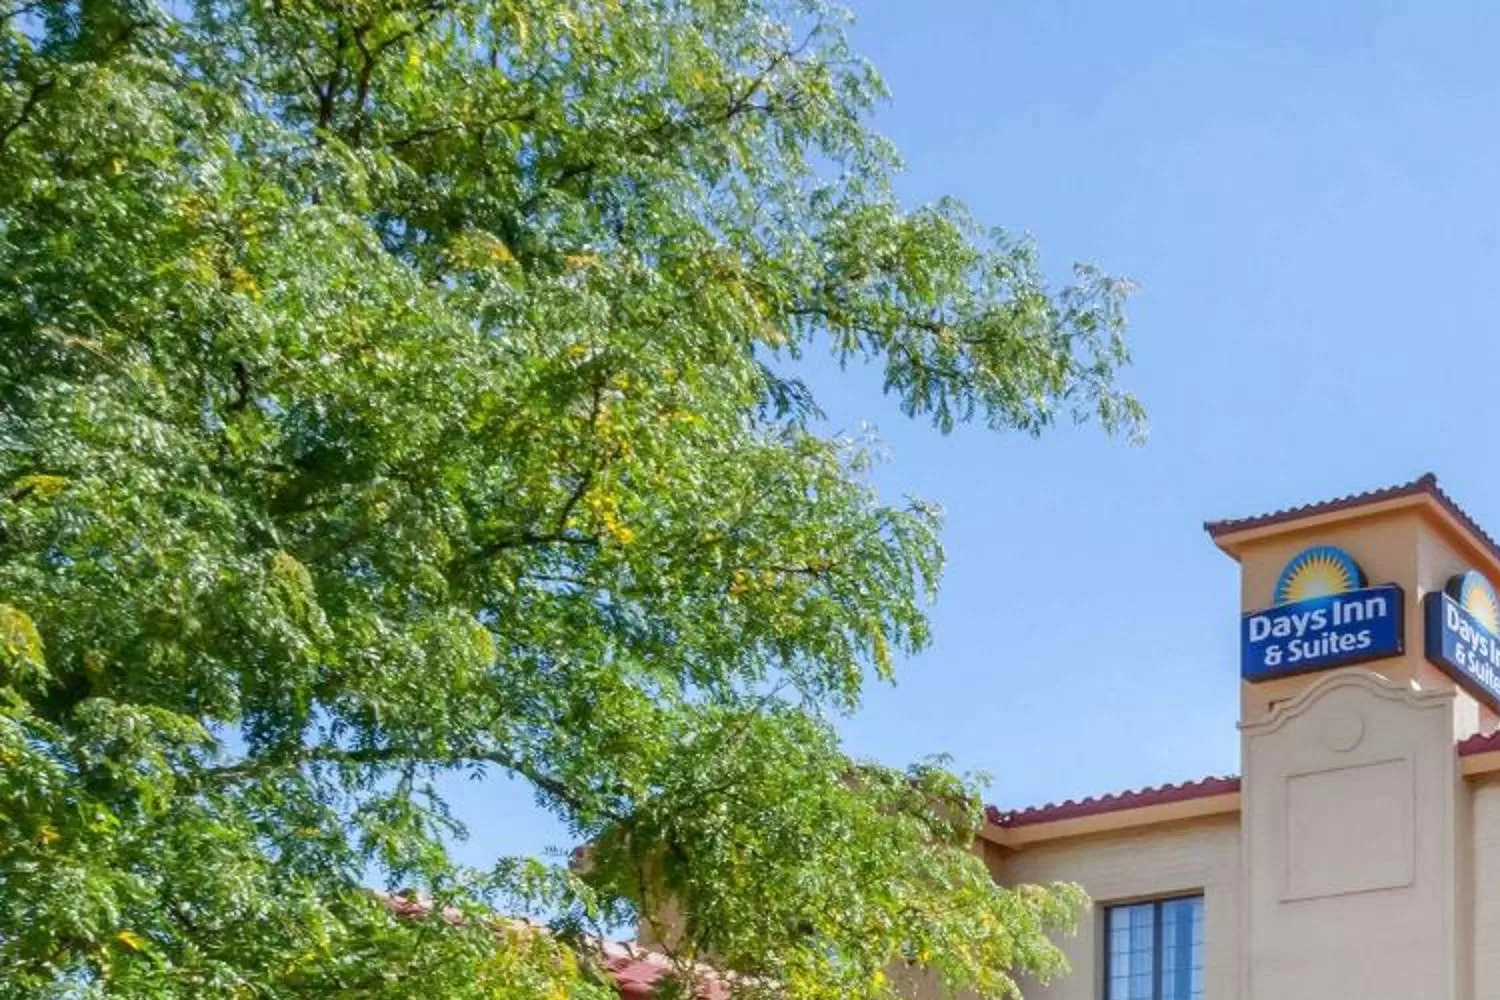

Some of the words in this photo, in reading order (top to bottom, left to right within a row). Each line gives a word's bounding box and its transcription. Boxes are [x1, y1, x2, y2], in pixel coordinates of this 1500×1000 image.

[1249, 609, 1326, 642] Days
[1333, 597, 1387, 626] Inn
[1447, 603, 1488, 656] Days
[1264, 646, 1281, 666] &
[1288, 628, 1371, 663] Suites
[1455, 646, 1465, 665] &
